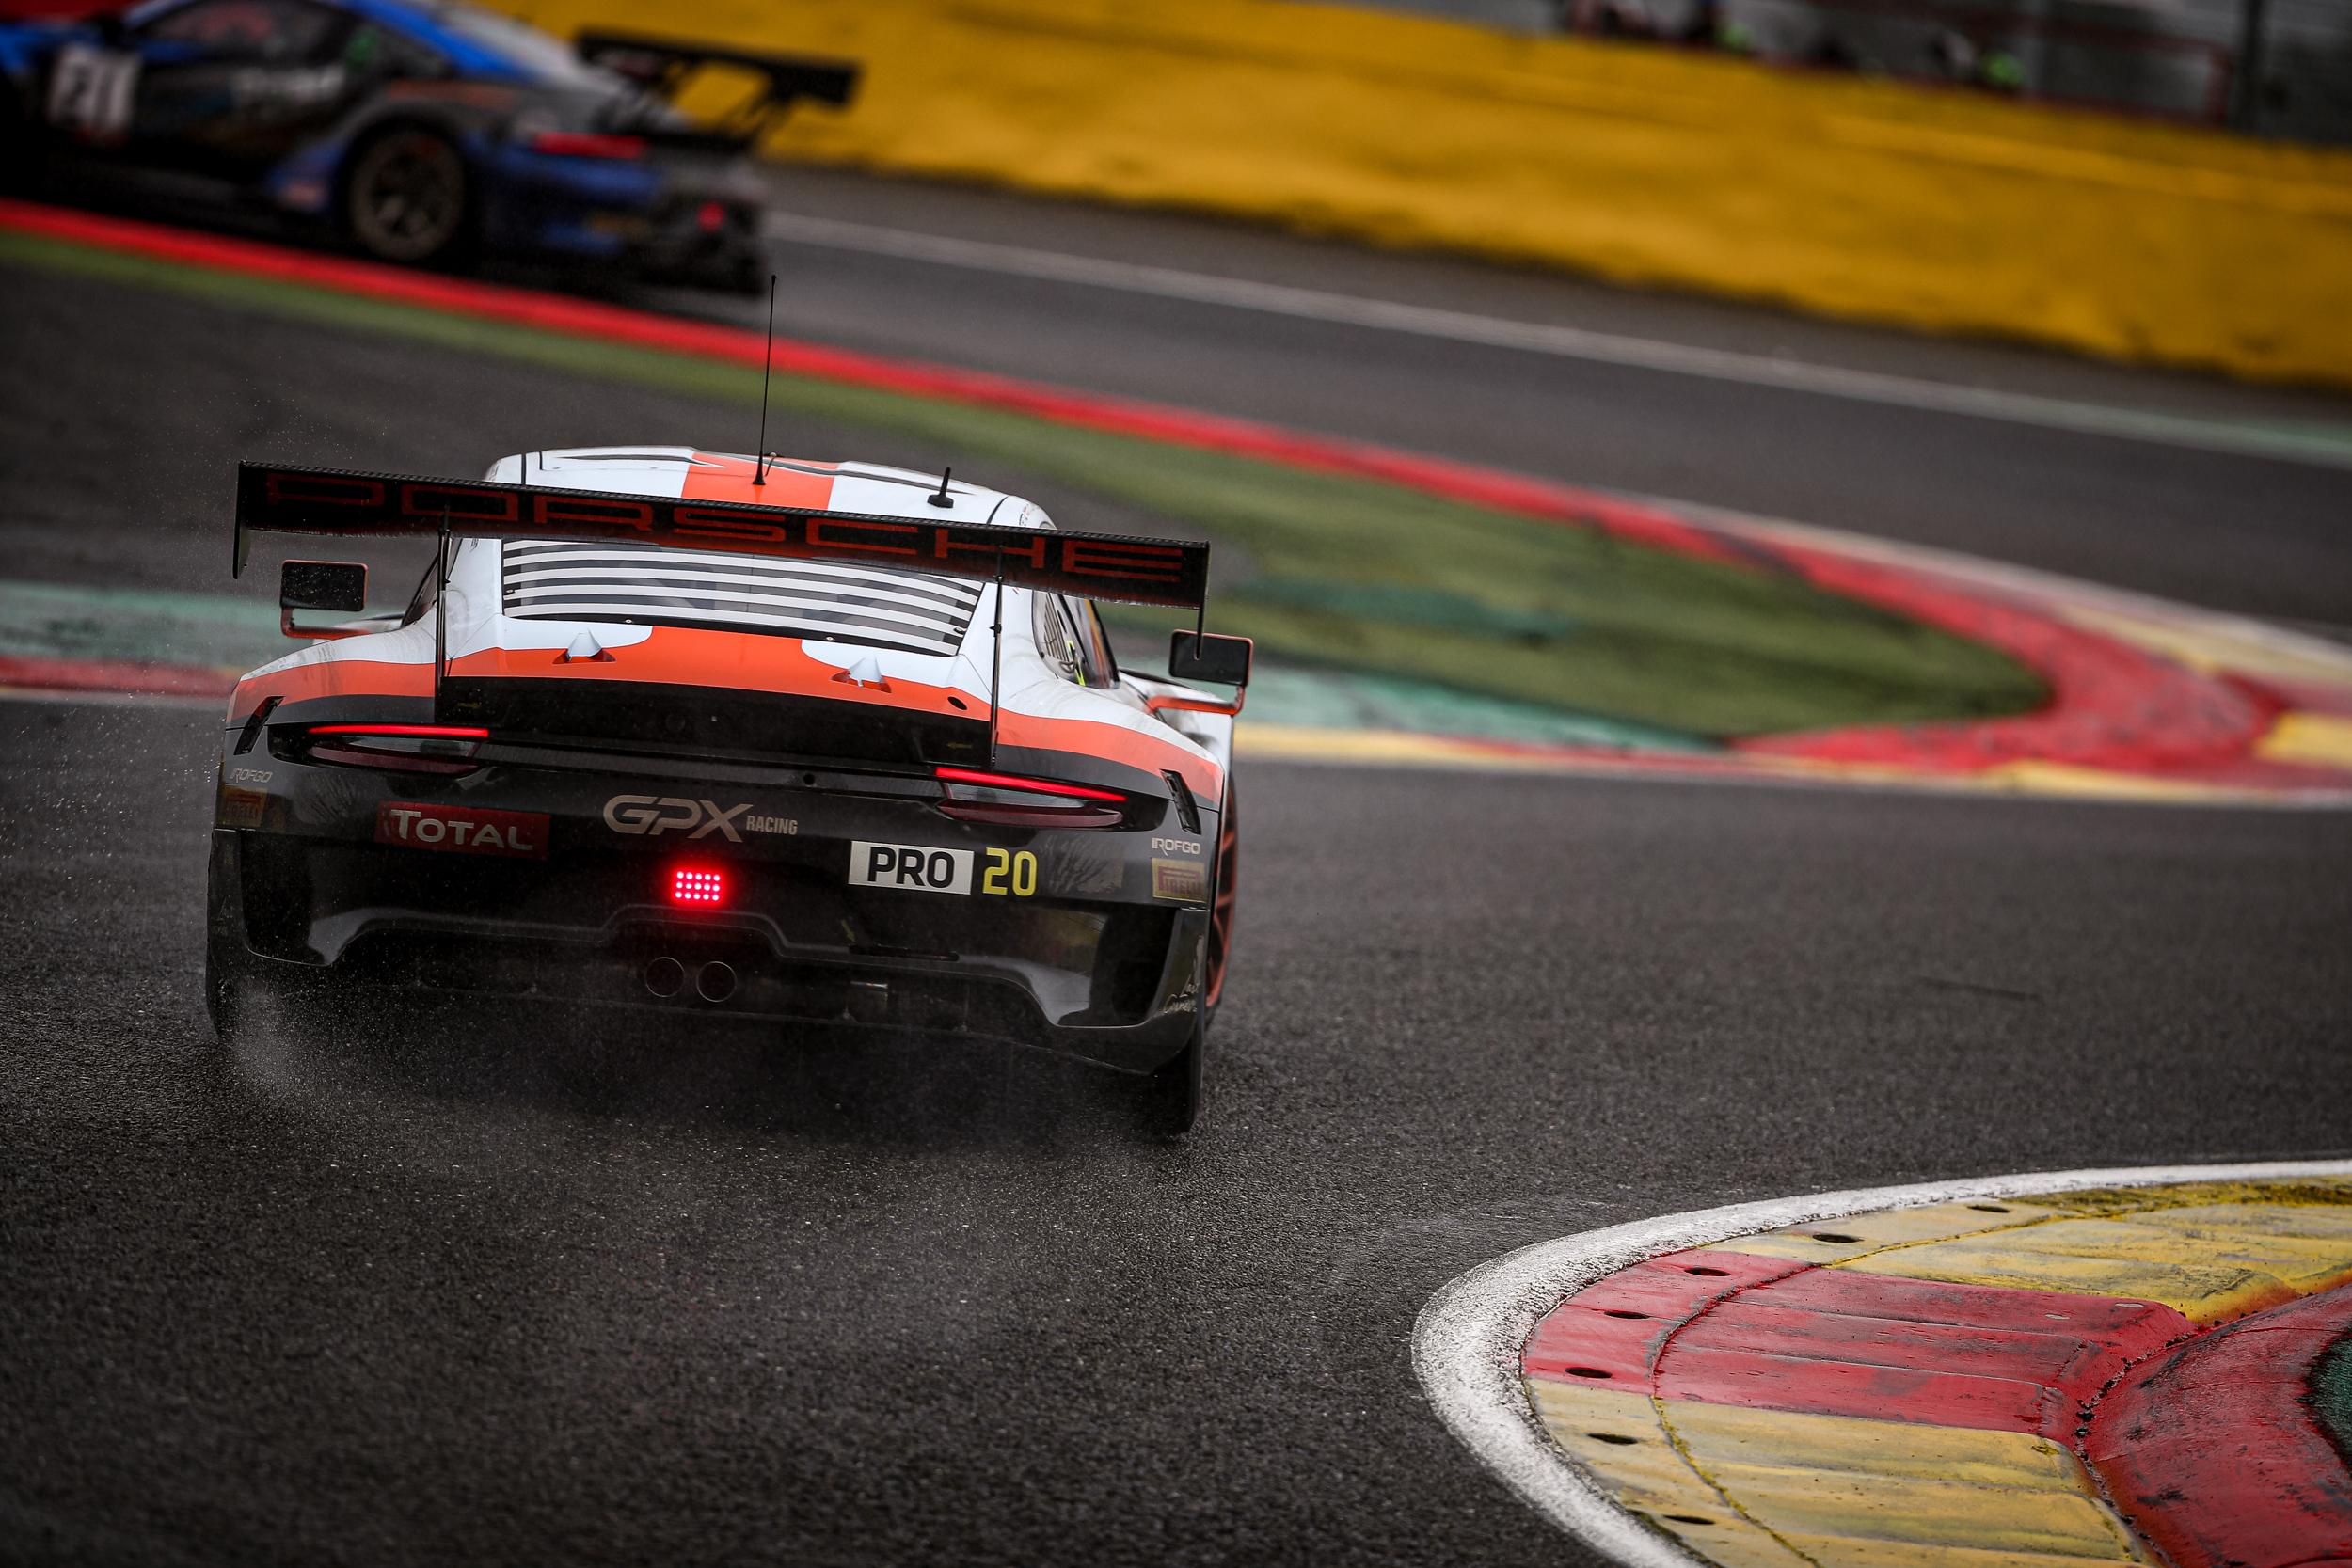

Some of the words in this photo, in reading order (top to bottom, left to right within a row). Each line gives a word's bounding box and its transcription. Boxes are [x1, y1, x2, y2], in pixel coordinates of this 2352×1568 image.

[266, 473, 1183, 582] PORSCHE
[390, 809, 533, 850] TOTAL
[603, 794, 754, 843] GPX
[746, 815, 799, 835] RACING
[867, 847, 955, 888] PRO
[982, 847, 1037, 896] 20
[1157, 866, 1202, 896] PIRELLI
